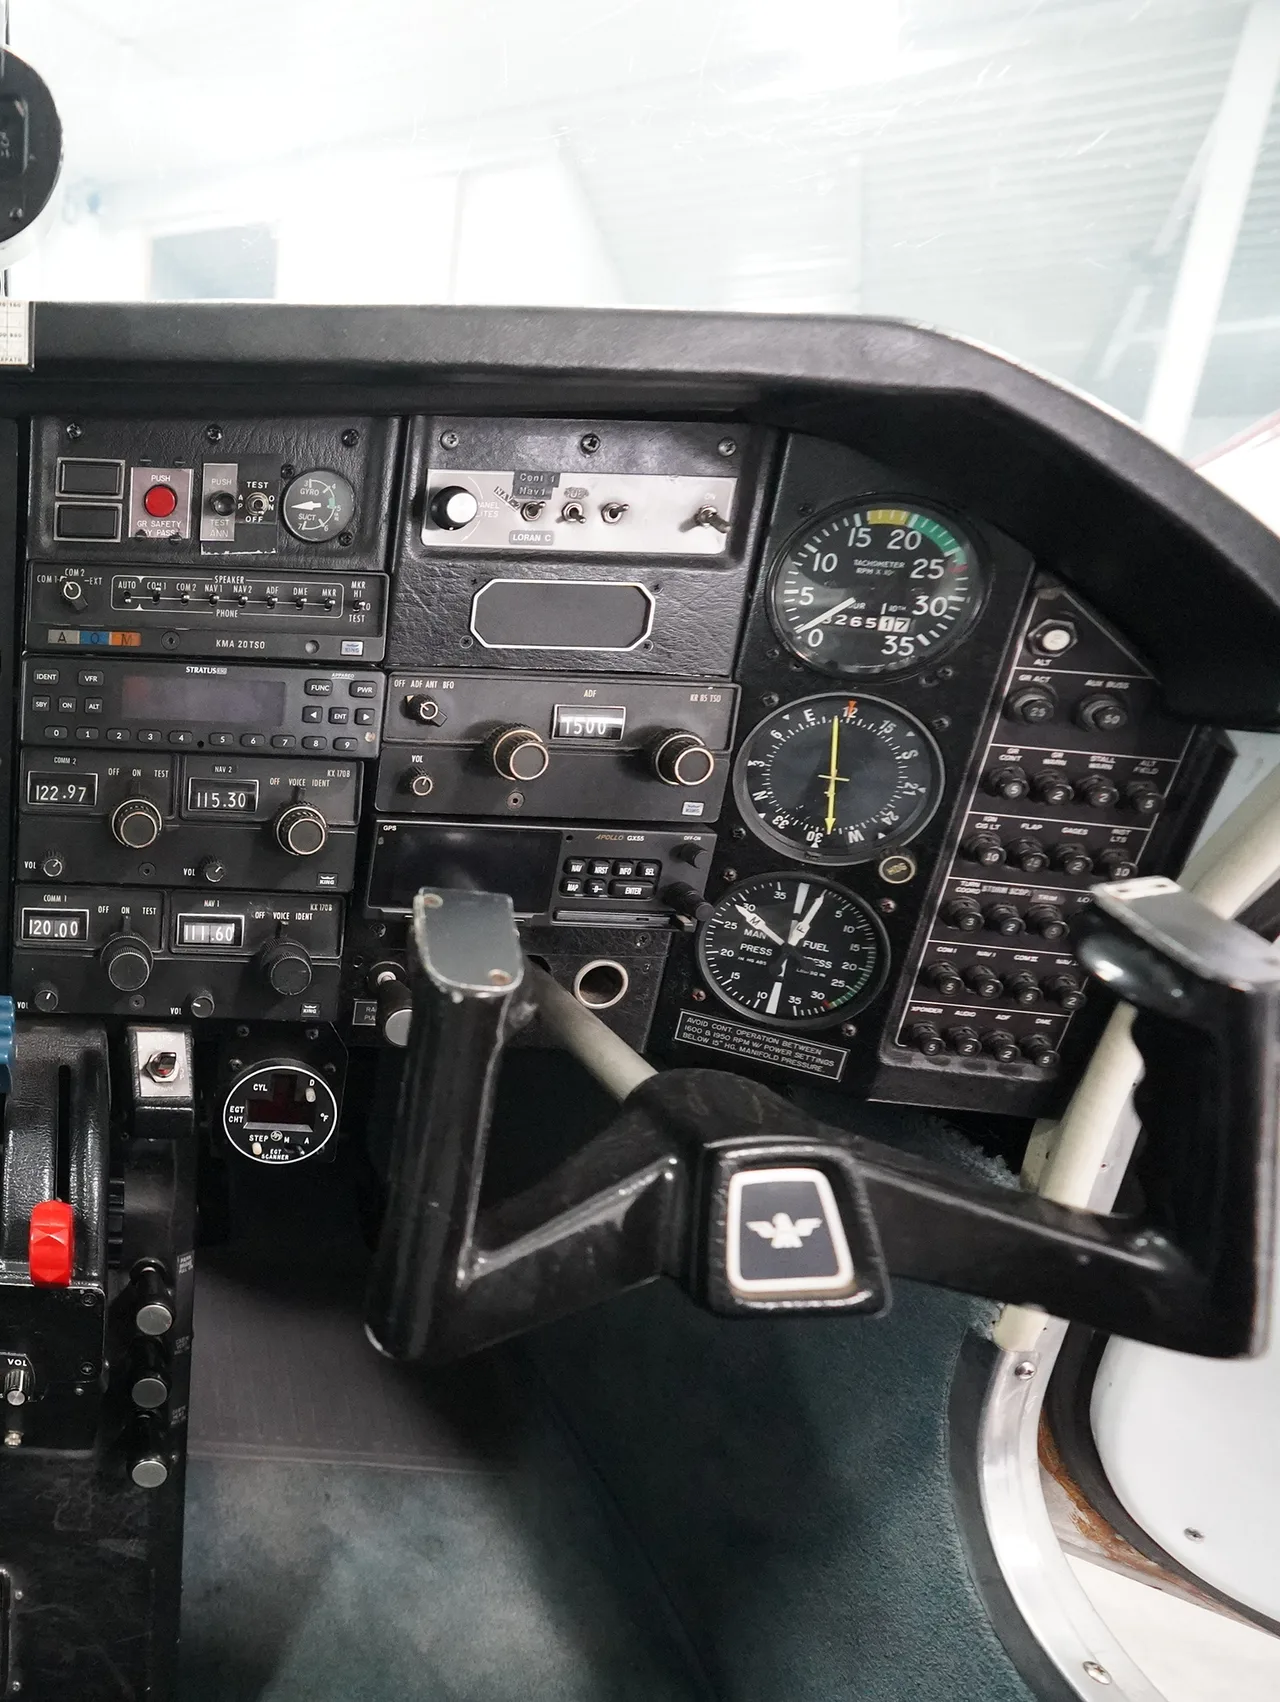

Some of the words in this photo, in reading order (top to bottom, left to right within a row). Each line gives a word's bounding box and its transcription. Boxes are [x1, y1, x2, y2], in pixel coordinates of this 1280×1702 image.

[300, 488, 319, 497] GYRO
[848, 528, 871, 547] 15
[887, 530, 922, 550] 20
[813, 553, 838, 572] 10
[910, 559, 944, 579] 25
[854, 560, 905, 568] TACHOMETER
[118, 581, 136, 589] AUTO
[214, 576, 244, 584] SPEAKER
[293, 588, 308, 596] DME
[322, 589, 337, 597] MKR
[216, 609, 238, 618] PHONE
[912, 596, 948, 616] 30
[349, 614, 365, 623] TEST
[216, 640, 234, 648] KMA
[250, 641, 265, 649] TSO
[808, 629, 823, 647] 0
[881, 636, 914, 656] 35
[565, 718, 606, 735] 1500
[1090, 756, 1115, 764] STALL
[36, 784, 86, 802] 122.97
[197, 792, 246, 808] 115.30
[29, 920, 78, 938] 120.00
[185, 922, 233, 942] 111.60
[724, 921, 737, 930] 25
[744, 929, 766, 939] MAN
[803, 940, 830, 952] FUEL
[721, 949, 734, 957] 20
[740, 943, 772, 956] PRESS
[686, 1018, 708, 1027] AVOID
[712, 1023, 732, 1033] CONT.
[736, 1029, 779, 1044] OPERATION
[782, 1040, 822, 1055] BETWEEN
[682, 1033, 709, 1044] BELOW
[739, 1046, 779, 1062] MANIFOLD
[782, 1057, 826, 1073] PRESSURE.
[684, 1025, 702, 1034] 1600
[713, 1032, 731, 1040] 1950
[733, 1036, 750, 1045] RPM
[764, 1044, 792, 1056] POWER
[794, 1052, 834, 1067] SETTINGS
